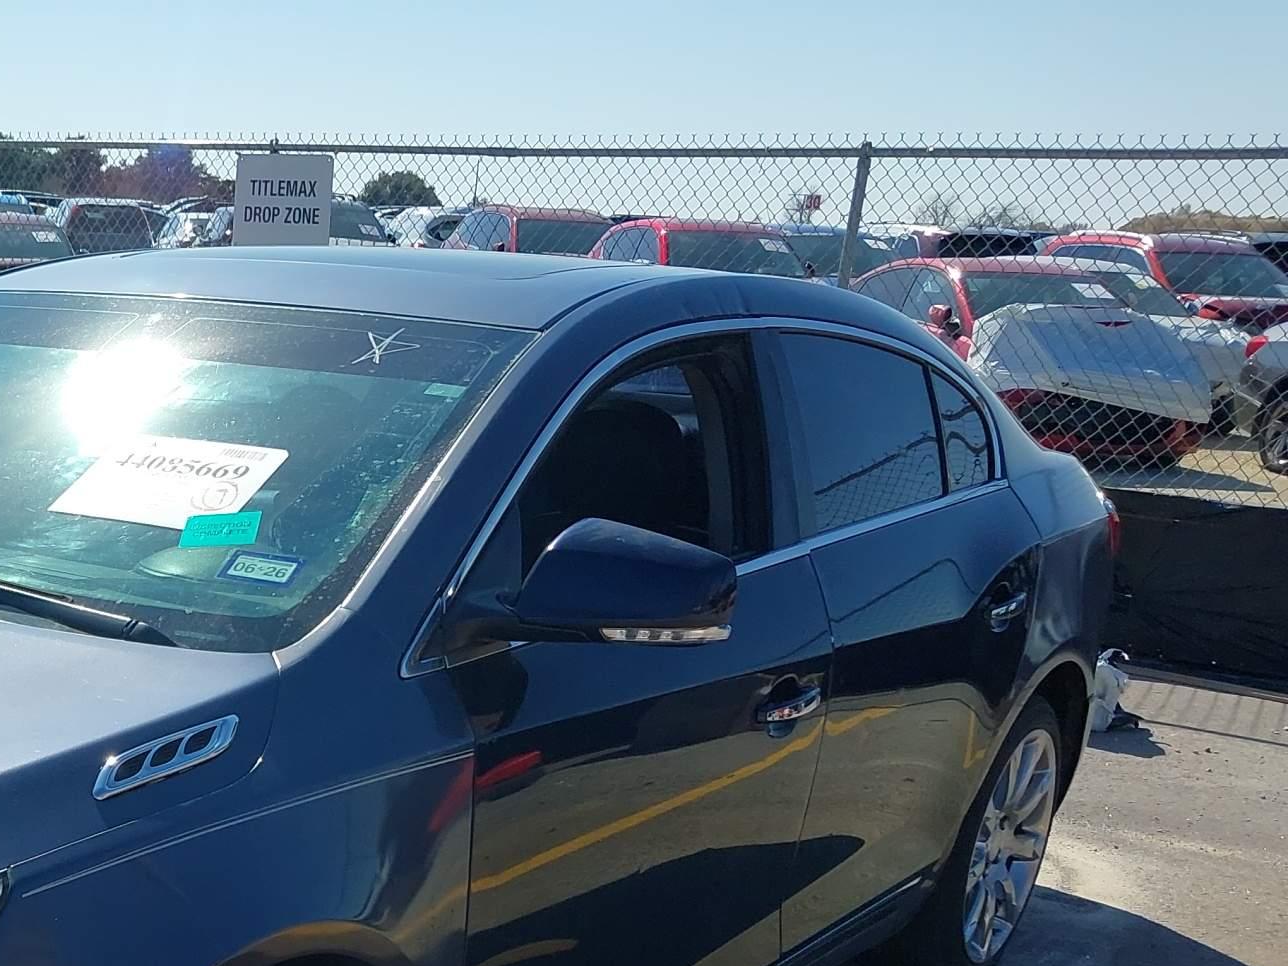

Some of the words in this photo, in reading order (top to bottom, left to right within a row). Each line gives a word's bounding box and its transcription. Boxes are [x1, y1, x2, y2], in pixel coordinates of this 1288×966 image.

[250, 179, 318, 198] TITLEMAX
[243, 205, 281, 224] DROP
[283, 207, 321, 225] ZONE
